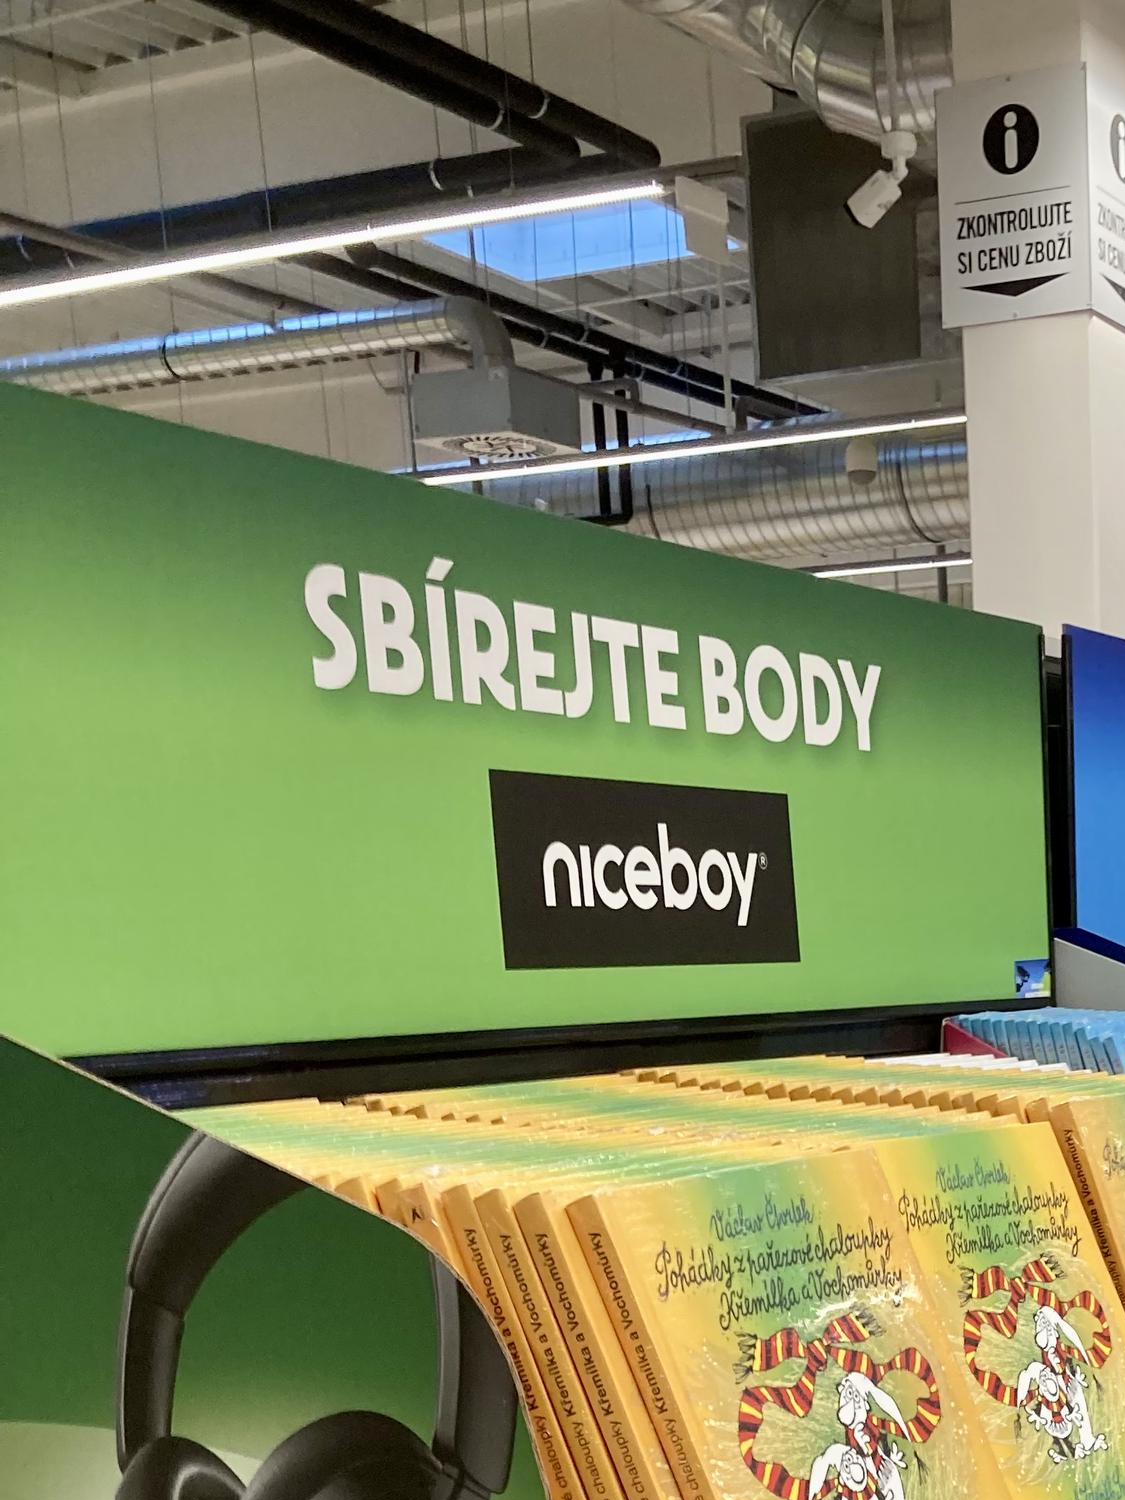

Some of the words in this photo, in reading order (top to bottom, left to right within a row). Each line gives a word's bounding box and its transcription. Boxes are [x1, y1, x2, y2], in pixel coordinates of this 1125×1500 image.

[957, 201, 1072, 241] ZKONTROLUJTE
[957, 252, 973, 274] SI
[977, 242, 1020, 272] CENU
[1025, 230, 1072, 265] ZBOŽÍ
[304, 556, 687, 732] SBÍREJTE
[698, 634, 882, 752] BODY
[935, 1161, 975, 1194] Václav
[710, 1203, 764, 1243] Václav
[898, 1187, 957, 1235] Pohádky
[955, 1205, 965, 1219] z
[964, 1191, 1012, 1230] pařezové
[1012, 1181, 1069, 1219] chaloupky
[655, 1240, 734, 1303] Pohádky
[732, 1257, 746, 1274] z
[748, 1232, 813, 1284] pařezové
[814, 1216, 894, 1262] chaloupky
[945, 1223, 1004, 1264] Křemílka
[1003, 1232, 1012, 1247] a
[1009, 1216, 1082, 1258] Vochomůrky
[719, 1275, 798, 1331] Křemílka
[801, 1283, 813, 1300] a
[807, 1257, 903, 1309] Vochomůrky
